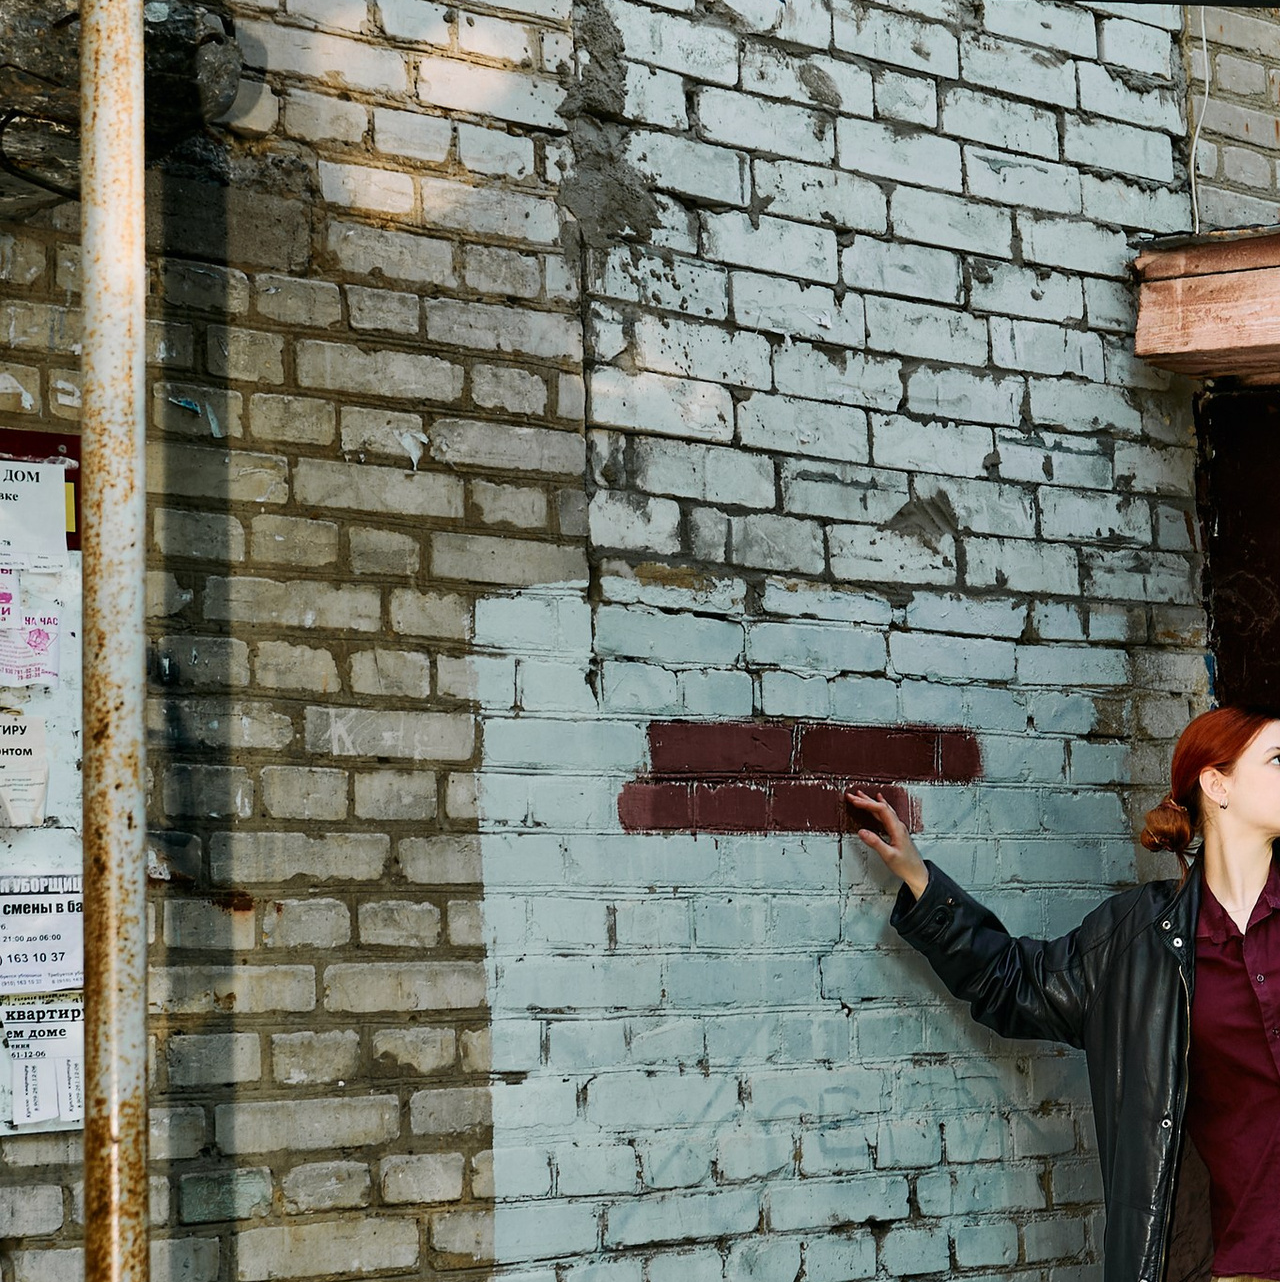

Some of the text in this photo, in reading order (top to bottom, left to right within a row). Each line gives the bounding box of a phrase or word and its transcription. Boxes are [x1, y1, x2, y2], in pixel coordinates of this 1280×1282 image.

[3, 469, 40, 483] ДОМ
[40, 617, 58, 626] ЧАС
[12, 877, 83, 894] УБОРЩИЦ
[3, 900, 84, 915] смены в ба
[7, 952, 65, 963] 163 10 37
[6, 1008, 84, 1023] квартир
[28, 1028, 67, 1039] доме
